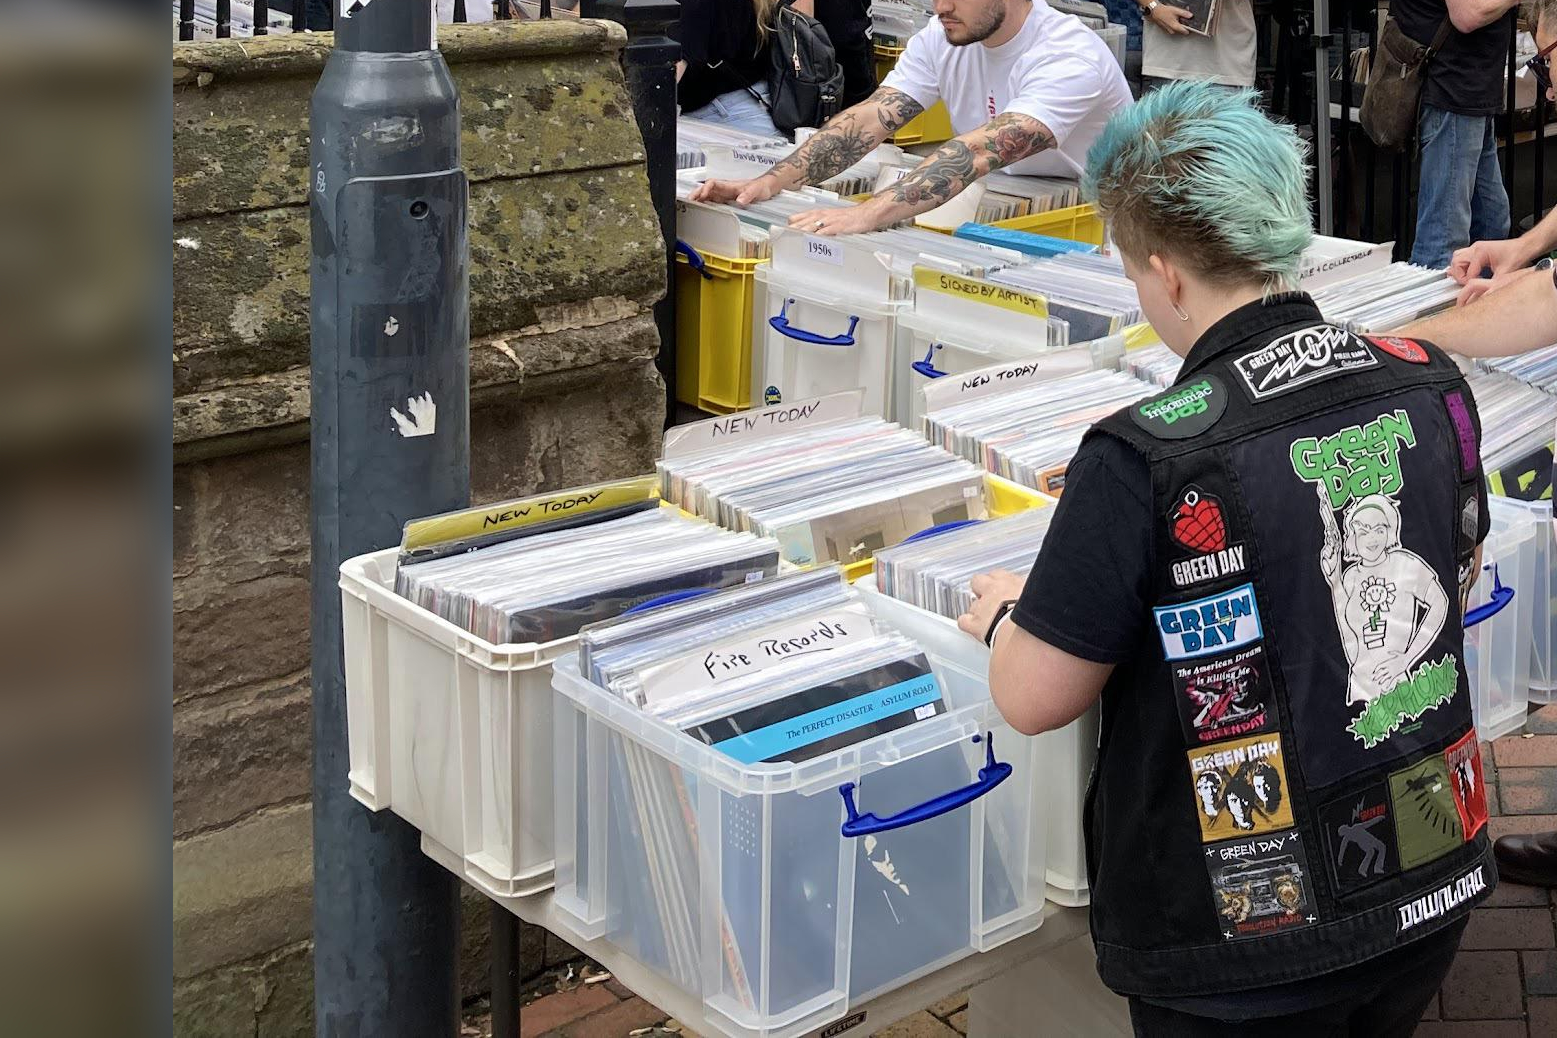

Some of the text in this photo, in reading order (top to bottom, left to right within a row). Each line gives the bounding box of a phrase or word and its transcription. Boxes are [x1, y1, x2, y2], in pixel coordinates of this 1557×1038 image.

[732, 147, 756, 162] David
[808, 241, 832, 257] 1950s
[940, 275, 1037, 309] SIGNED BY ARTIST
[1249, 342, 1293, 370] GREEN DAY
[961, 362, 1039, 392] NEW TODAY
[711, 400, 820, 438] NEW TODAY
[483, 490, 605, 529] NEW TODAY
[1172, 545, 1245, 586] GREEN DAY
[1160, 595, 1252, 634] GREEN
[1181, 620, 1238, 653] DAY
[1177, 646, 1262, 678] The American Dream
[1196, 667, 1251, 685] is Killing Me
[786, 683, 934, 739] The PERFECT DISASTER ASYLUM ROAD
[1191, 740, 1279, 773] GREEN DAY
[1219, 837, 1285, 861] GREEN DAY
[1398, 866, 1487, 930] DOWNLOAD
